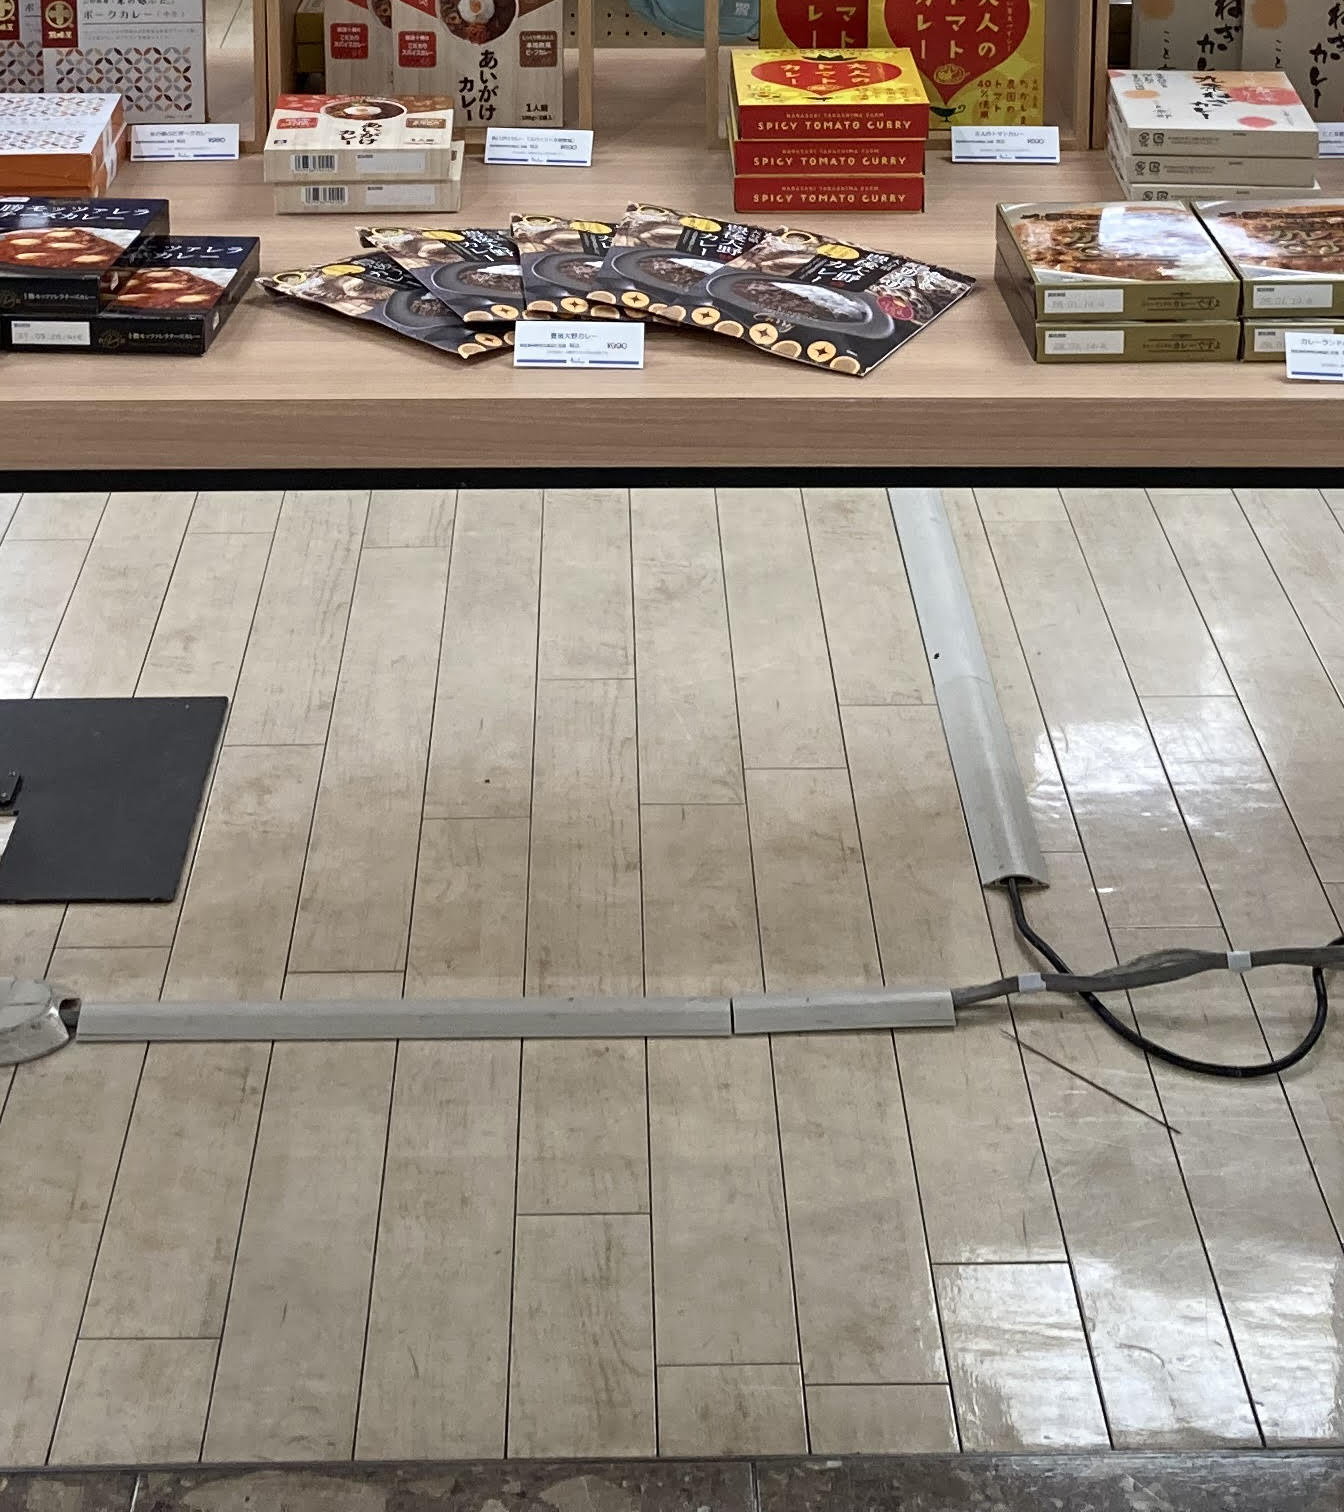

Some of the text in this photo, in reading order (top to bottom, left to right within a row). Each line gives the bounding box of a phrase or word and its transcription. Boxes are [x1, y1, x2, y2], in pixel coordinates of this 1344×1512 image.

[479, 49, 499, 121] あいがけ
[458, 76, 476, 121] カレー
[758, 121, 911, 130] SPICY TOMATO CURRY
[754, 157, 906, 166] SPICY TOMATO CURRY
[753, 194, 906, 203] SPICY TOMATO CURRY
